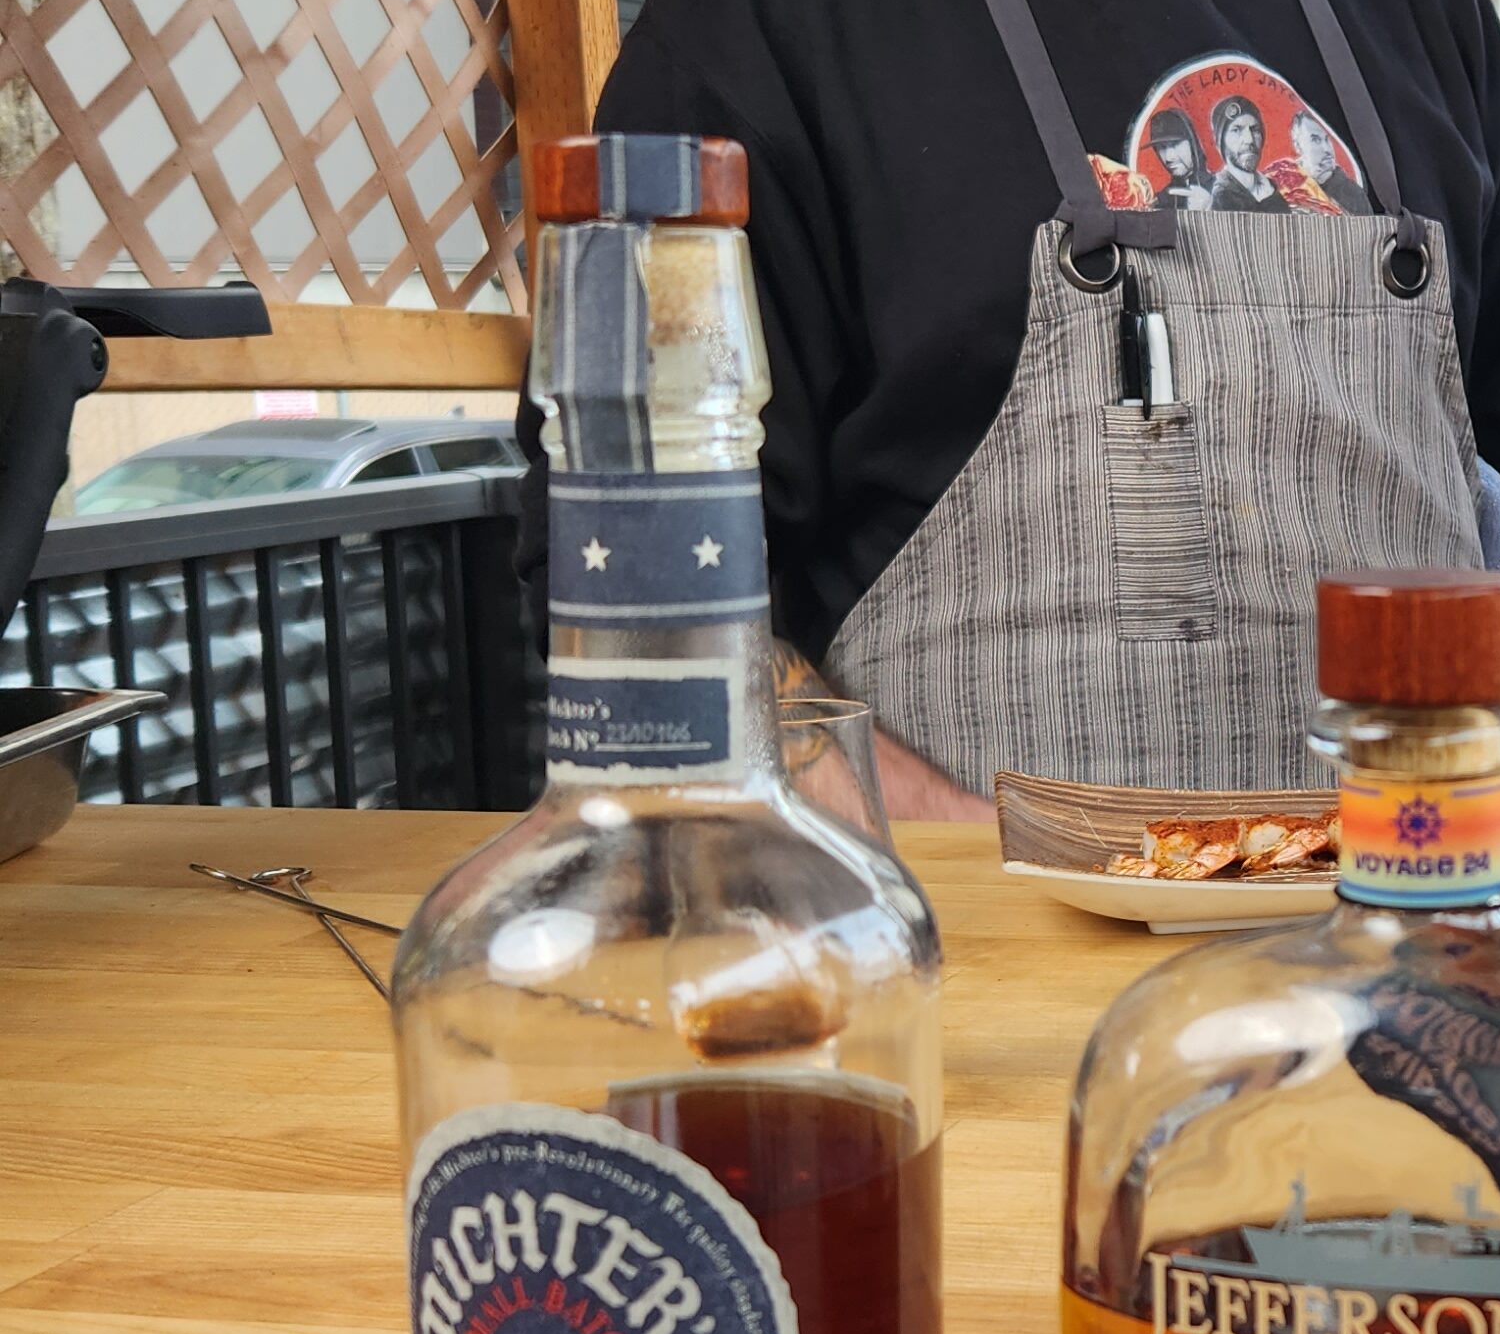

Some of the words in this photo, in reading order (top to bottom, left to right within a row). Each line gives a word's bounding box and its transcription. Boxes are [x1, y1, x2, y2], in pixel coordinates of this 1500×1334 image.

[1168, 82, 1193, 107] THE
[1199, 68, 1249, 88] LADY
[1355, 851, 1456, 876] VOYAGE
